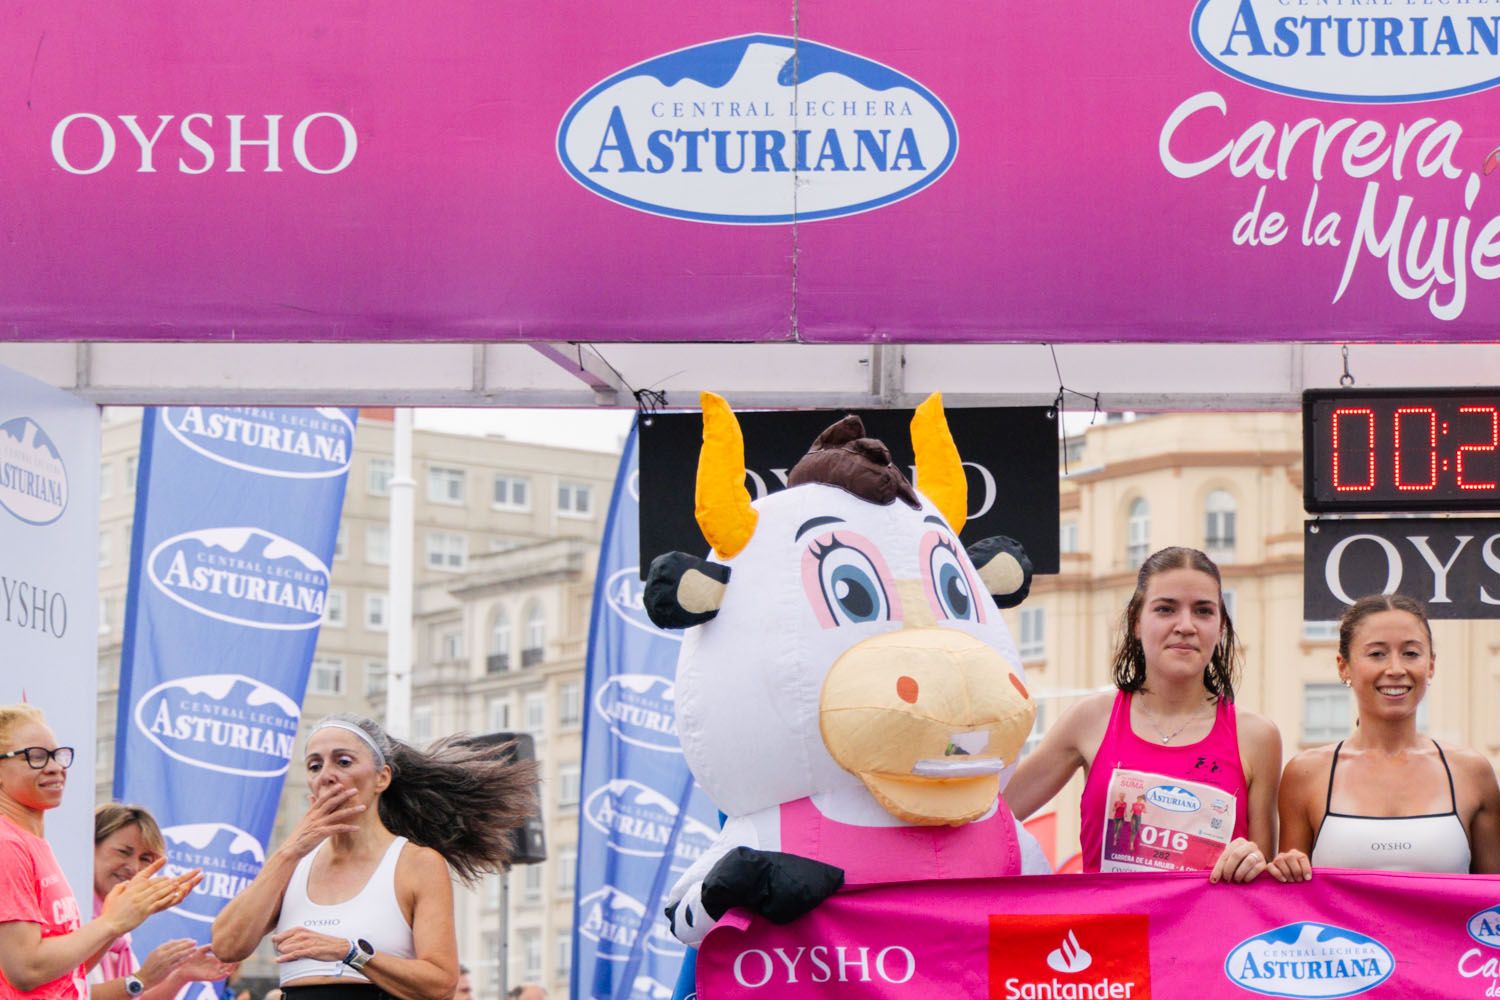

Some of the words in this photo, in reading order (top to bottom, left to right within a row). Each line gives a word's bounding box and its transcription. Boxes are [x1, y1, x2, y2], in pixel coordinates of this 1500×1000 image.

[651, 101, 776, 119] CENTRAL
[788, 101, 914, 119] LECHERA
[51, 112, 358, 175] OYSHO
[588, 105, 928, 174] ASTURIANA
[1158, 91, 1464, 180] Carrera
[1232, 185, 1290, 247] de
[1301, 184, 1341, 247] la
[177, 405, 347, 465] ASTURIANA
[197, 551, 262, 573] CENTRAL
[162, 549, 324, 616] ASTURIANA
[1, 576, 67, 638] YSHO
[180, 700, 245, 721] CENTRAL
[149, 697, 295, 760] ASTURIAN
[1149, 790, 1197, 810] ASTURIANA
[1141, 826, 1189, 851] 016
[1371, 842, 1412, 851] OYSHO
[304, 919, 341, 927] OYSHO
[733, 945, 916, 988] OYSHO
[1239, 951, 1383, 980] ASTURIANA
[1263, 949, 1319, 958] CENTRAL
[1327, 947, 1376, 956] LECHERA
[1005, 977, 1135, 1000] Santander
